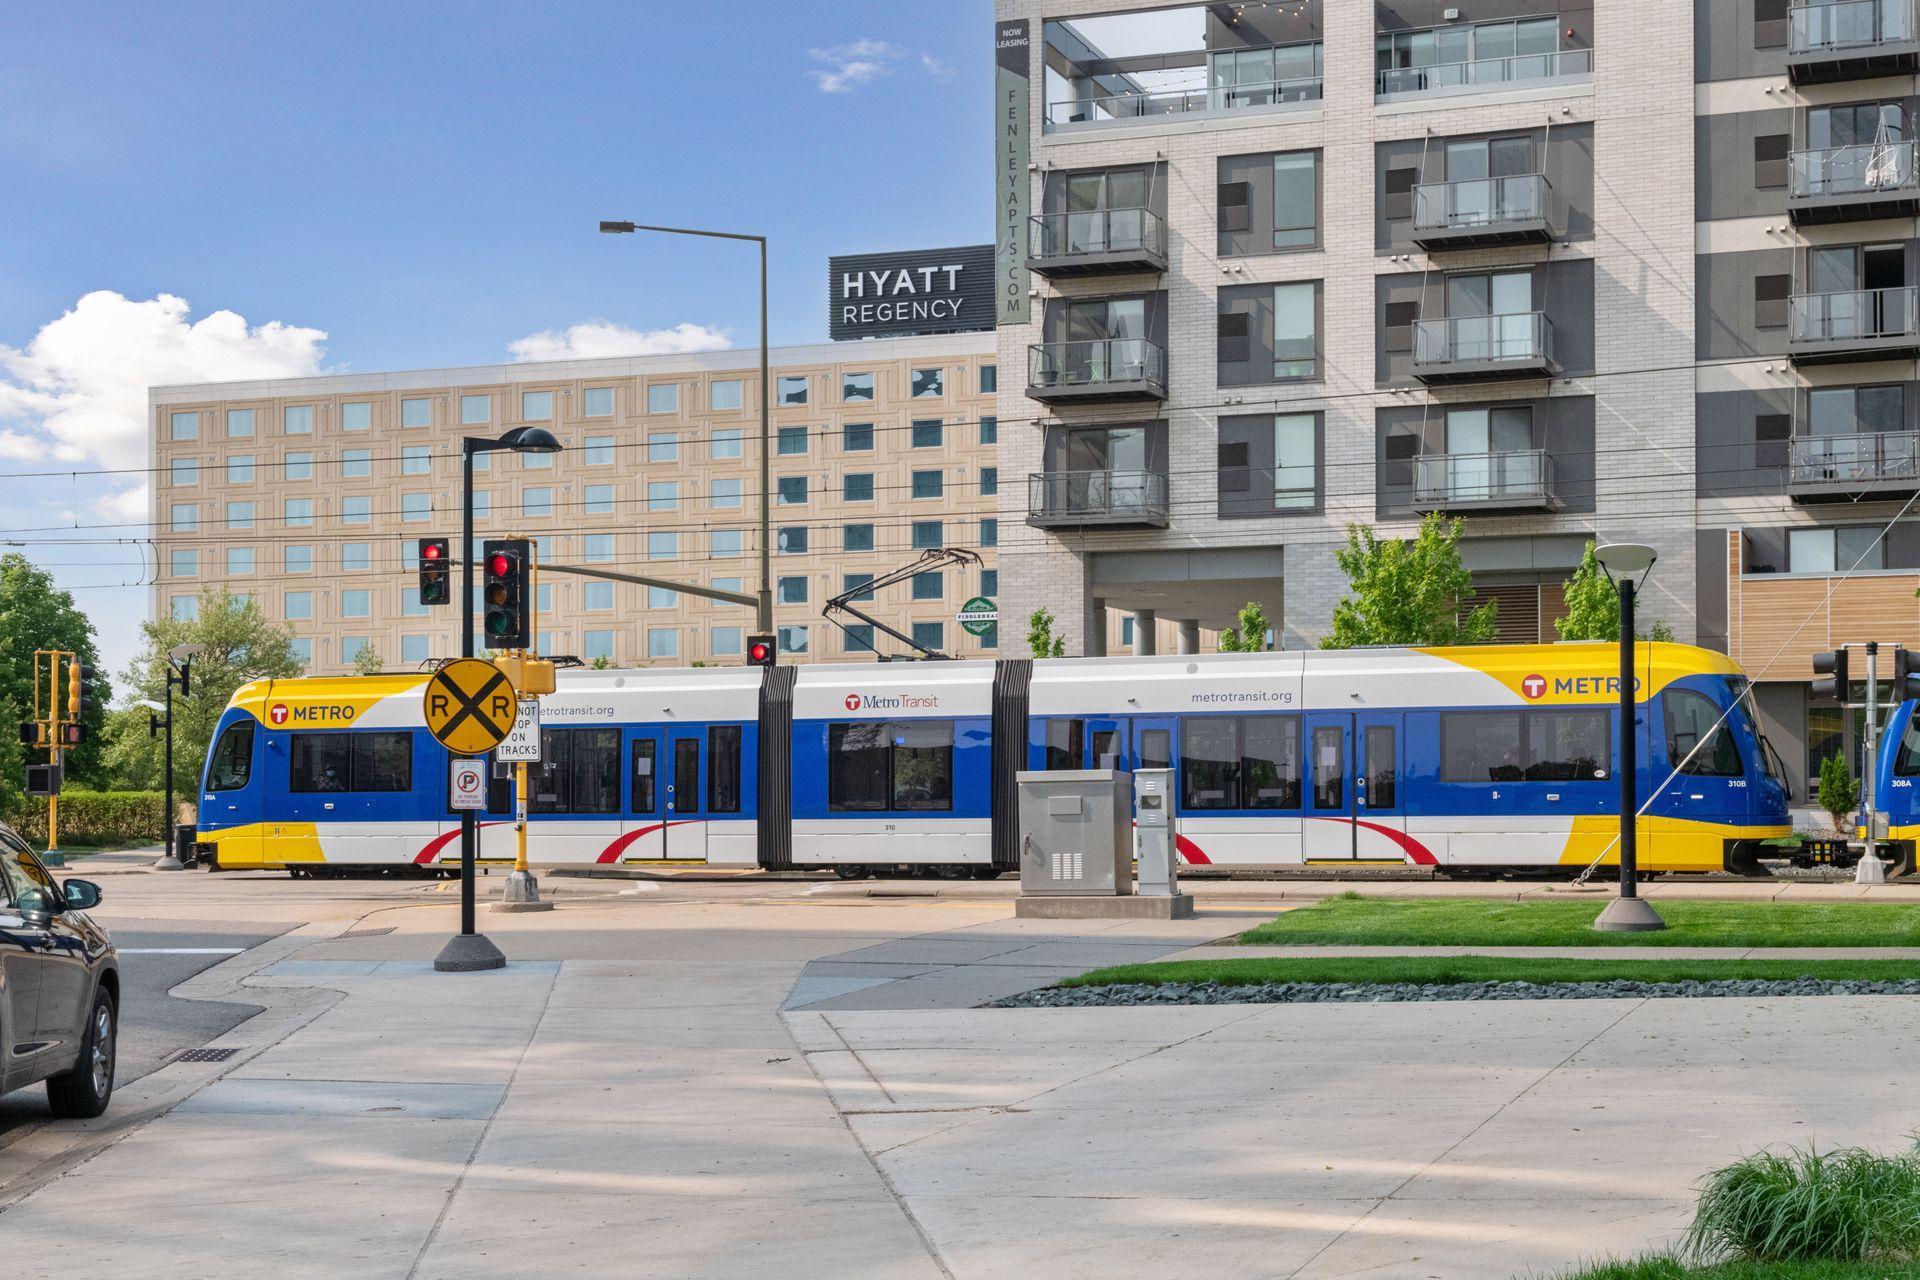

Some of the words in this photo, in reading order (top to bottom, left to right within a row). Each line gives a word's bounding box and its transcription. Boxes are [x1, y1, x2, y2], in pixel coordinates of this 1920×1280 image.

[1002, 28, 1022, 37] NOW
[996, 38, 1028, 48] LEASING
[843, 264, 963, 298] HYATT
[843, 298, 963, 324] REGENCY
[1191, 690, 1292, 704] metrotransit.org
[431, 694, 449, 717] R
[492, 695, 510, 718] R
[517, 706, 536, 716] NOT
[540, 705, 614, 717] etrotransit.org
[293, 705, 355, 721] METRO
[511, 732, 526, 742] ON
[500, 745, 538, 755] TRACKS
